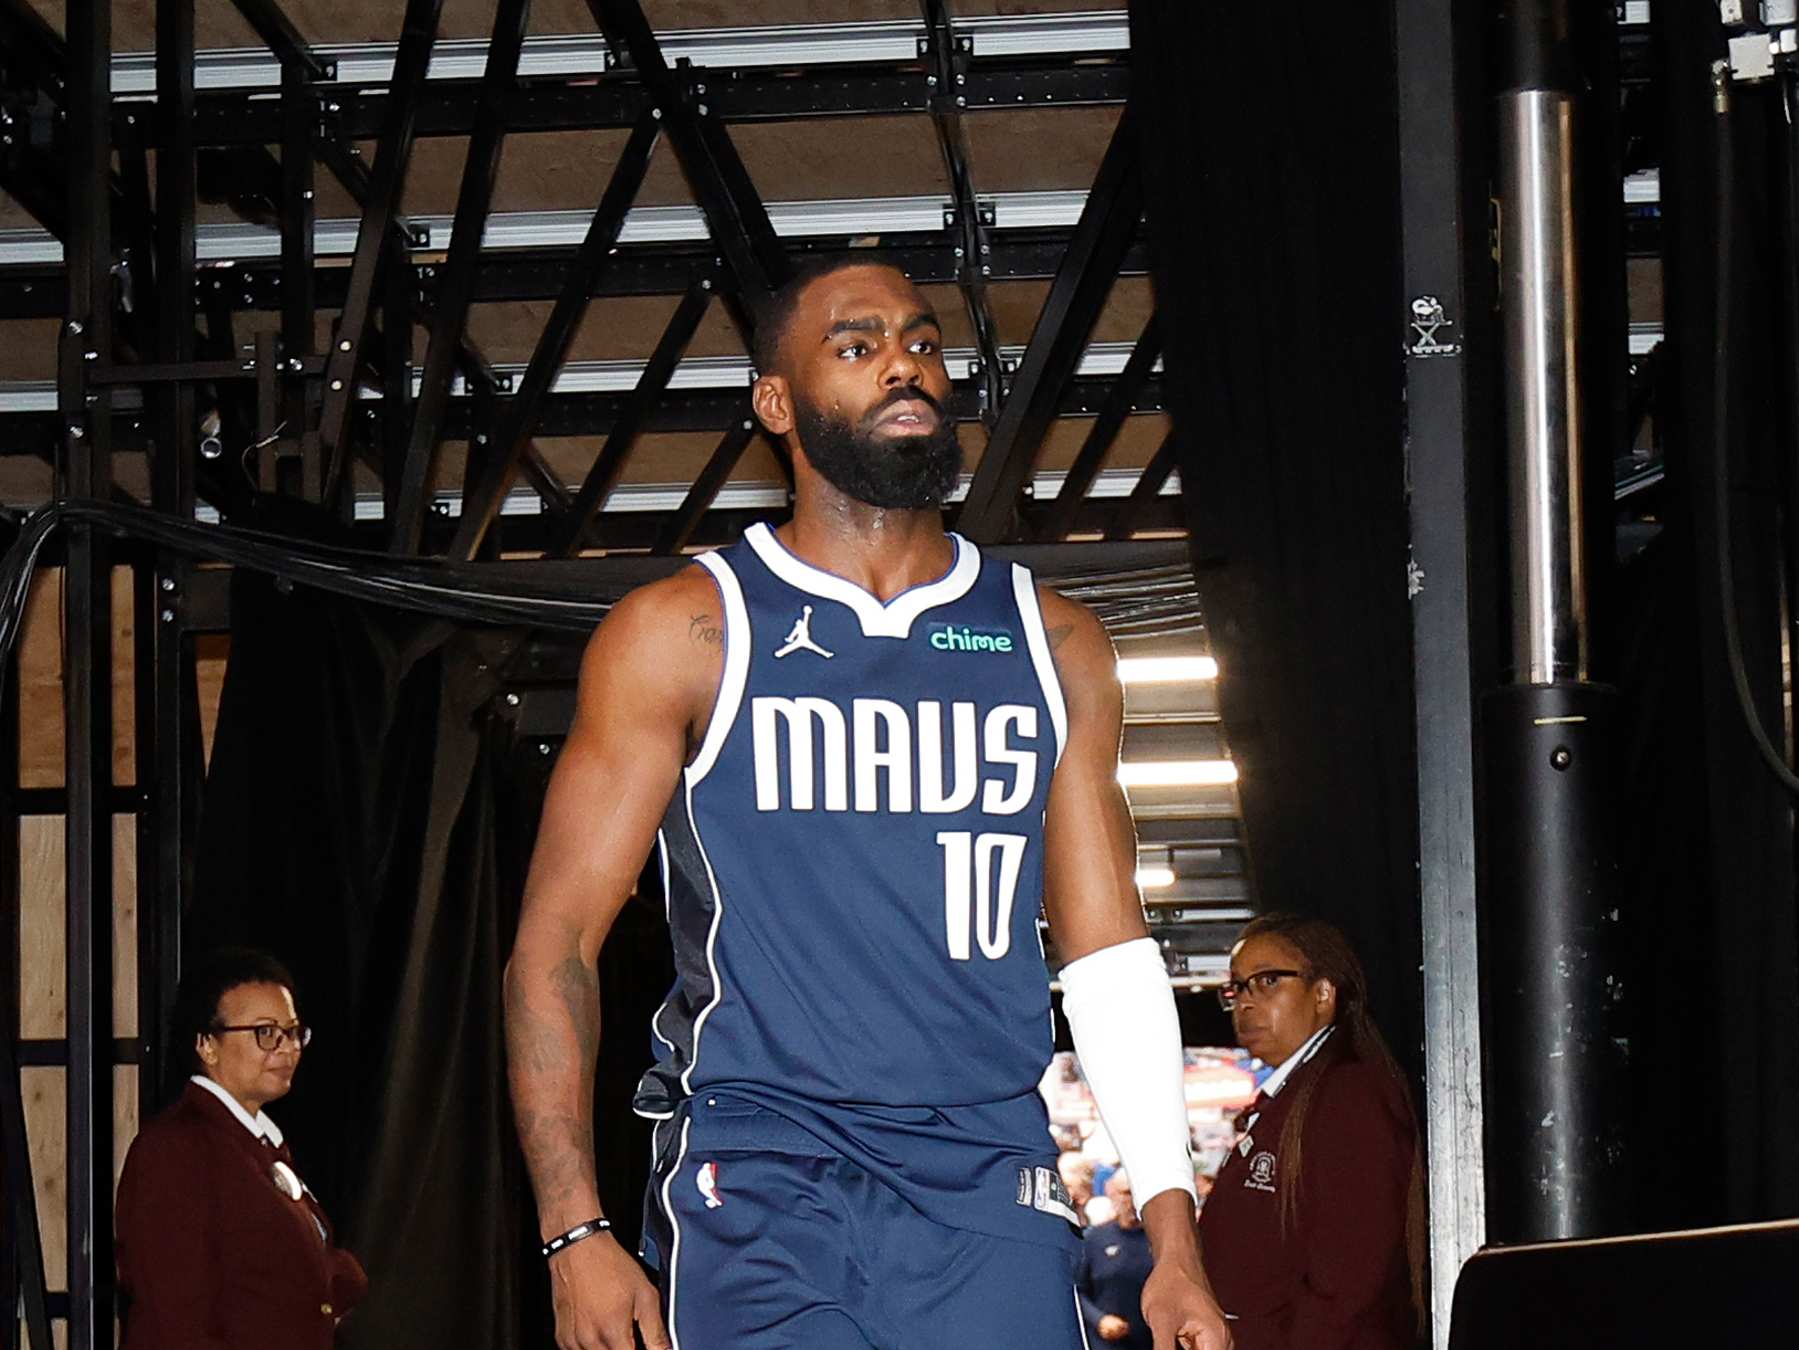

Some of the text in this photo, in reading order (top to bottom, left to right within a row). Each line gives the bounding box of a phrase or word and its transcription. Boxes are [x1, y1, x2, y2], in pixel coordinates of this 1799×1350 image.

[930, 625, 1013, 653] chime
[751, 696, 1038, 815] MAVS
[936, 831, 1028, 961] 10
